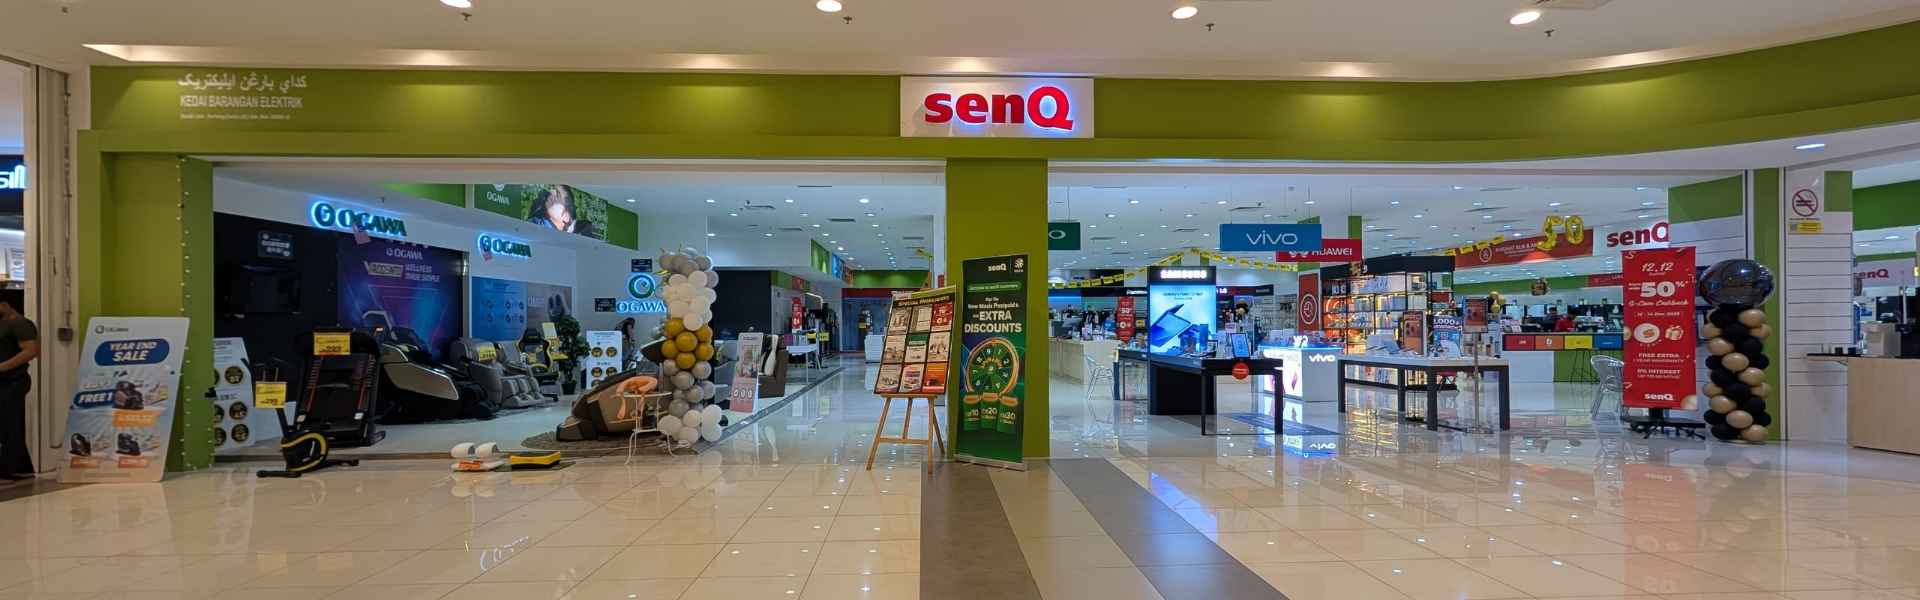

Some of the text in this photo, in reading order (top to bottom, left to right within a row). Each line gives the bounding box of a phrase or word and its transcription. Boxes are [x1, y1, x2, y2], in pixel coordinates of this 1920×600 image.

[180, 96, 304, 109] KEDAI BARANGAN ELEKTRIK
[924, 86, 1073, 130] senQ
[486, 192, 511, 206] OGAWA
[337, 210, 407, 237] OGAWA
[1246, 230, 1298, 246] vivo
[1537, 215, 1584, 251] 50
[1606, 221, 1669, 248] senQ
[492, 237, 532, 257] OGAWA
[394, 248, 423, 260] OGAWA
[988, 264, 1007, 272] senQ
[1641, 262, 1674, 272] 12.12
[1160, 269, 1207, 279] SAMSUNG
[617, 301, 667, 313] OGAWA
[979, 310, 1013, 321] EXTRA
[965, 322, 1023, 334] DISCOUNTS
[110, 340, 158, 352] YEAR END
[112, 350, 150, 362] SALE
[1308, 353, 1337, 363] vivo
[79, 393, 107, 404] FREE
